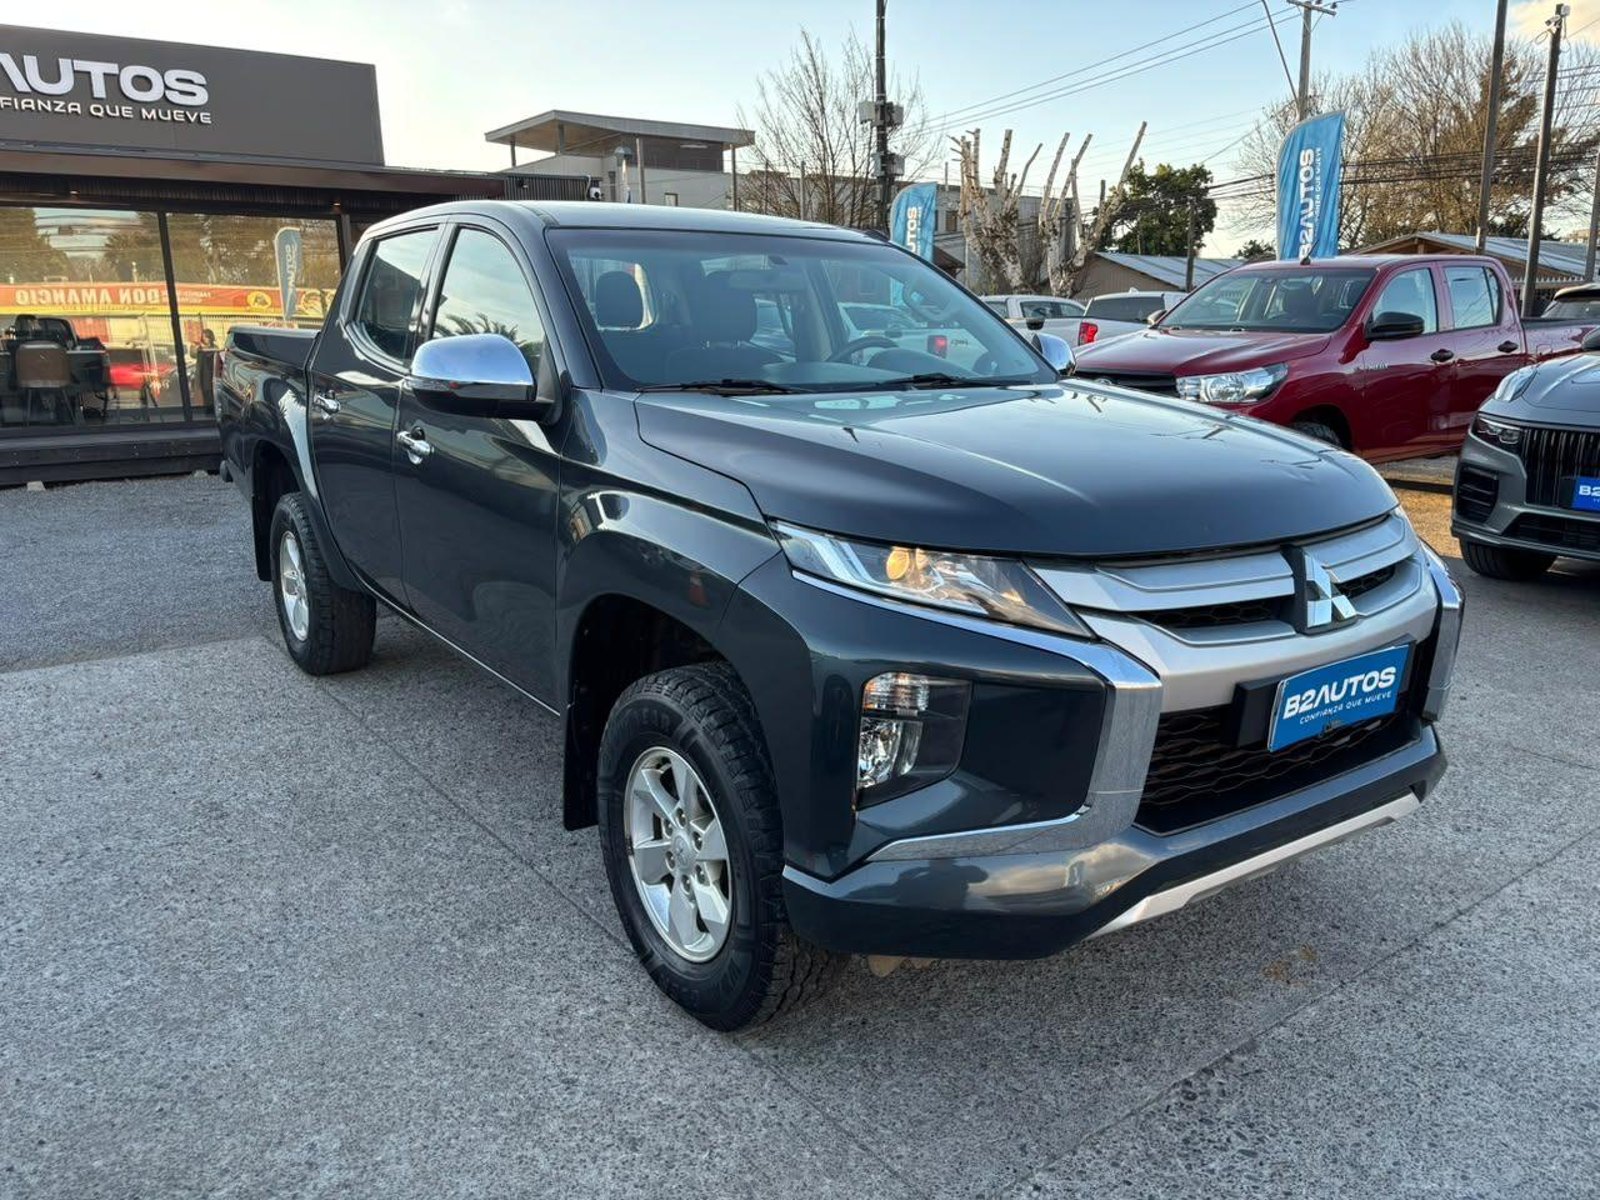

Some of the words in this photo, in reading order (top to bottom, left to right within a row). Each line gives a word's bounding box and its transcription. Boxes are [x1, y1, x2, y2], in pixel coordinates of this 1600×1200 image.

[89, 104, 134, 118] QUE
[141, 107, 212, 124] MUEVE
[1283, 666, 1396, 719] B2AUTOS
[1300, 703, 1343, 724] CONFIANZA
[1346, 699, 1362, 709] QUE
[1365, 690, 1392, 704] MUEVE
